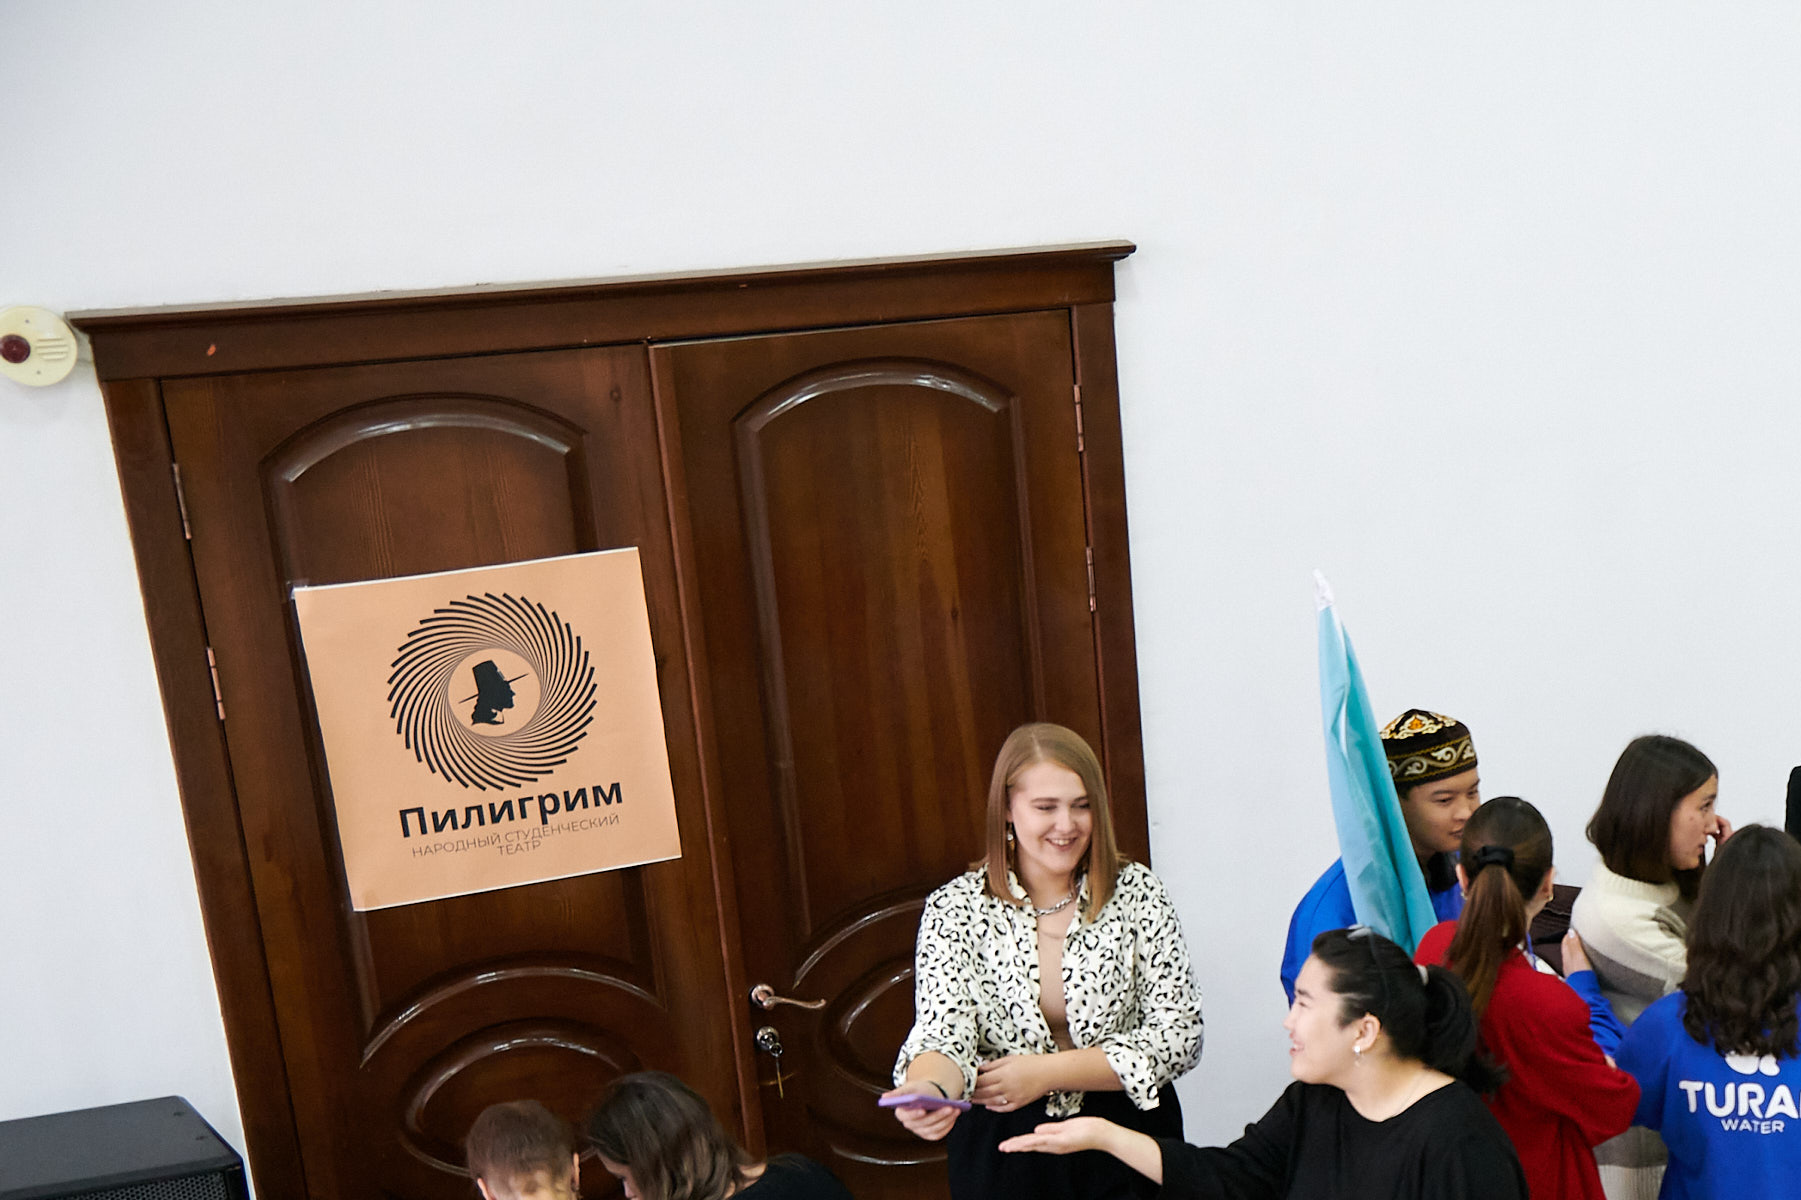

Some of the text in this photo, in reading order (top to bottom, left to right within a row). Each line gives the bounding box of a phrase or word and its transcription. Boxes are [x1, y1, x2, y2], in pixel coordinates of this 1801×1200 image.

[399, 782, 623, 838] Пилигрим
[412, 814, 620, 857] НАРОДНЫЙ СТУДЕНЧЕСКИЙ
[499, 841, 542, 856] ТЕАТР
[1721, 1118, 1785, 1135] WATER
